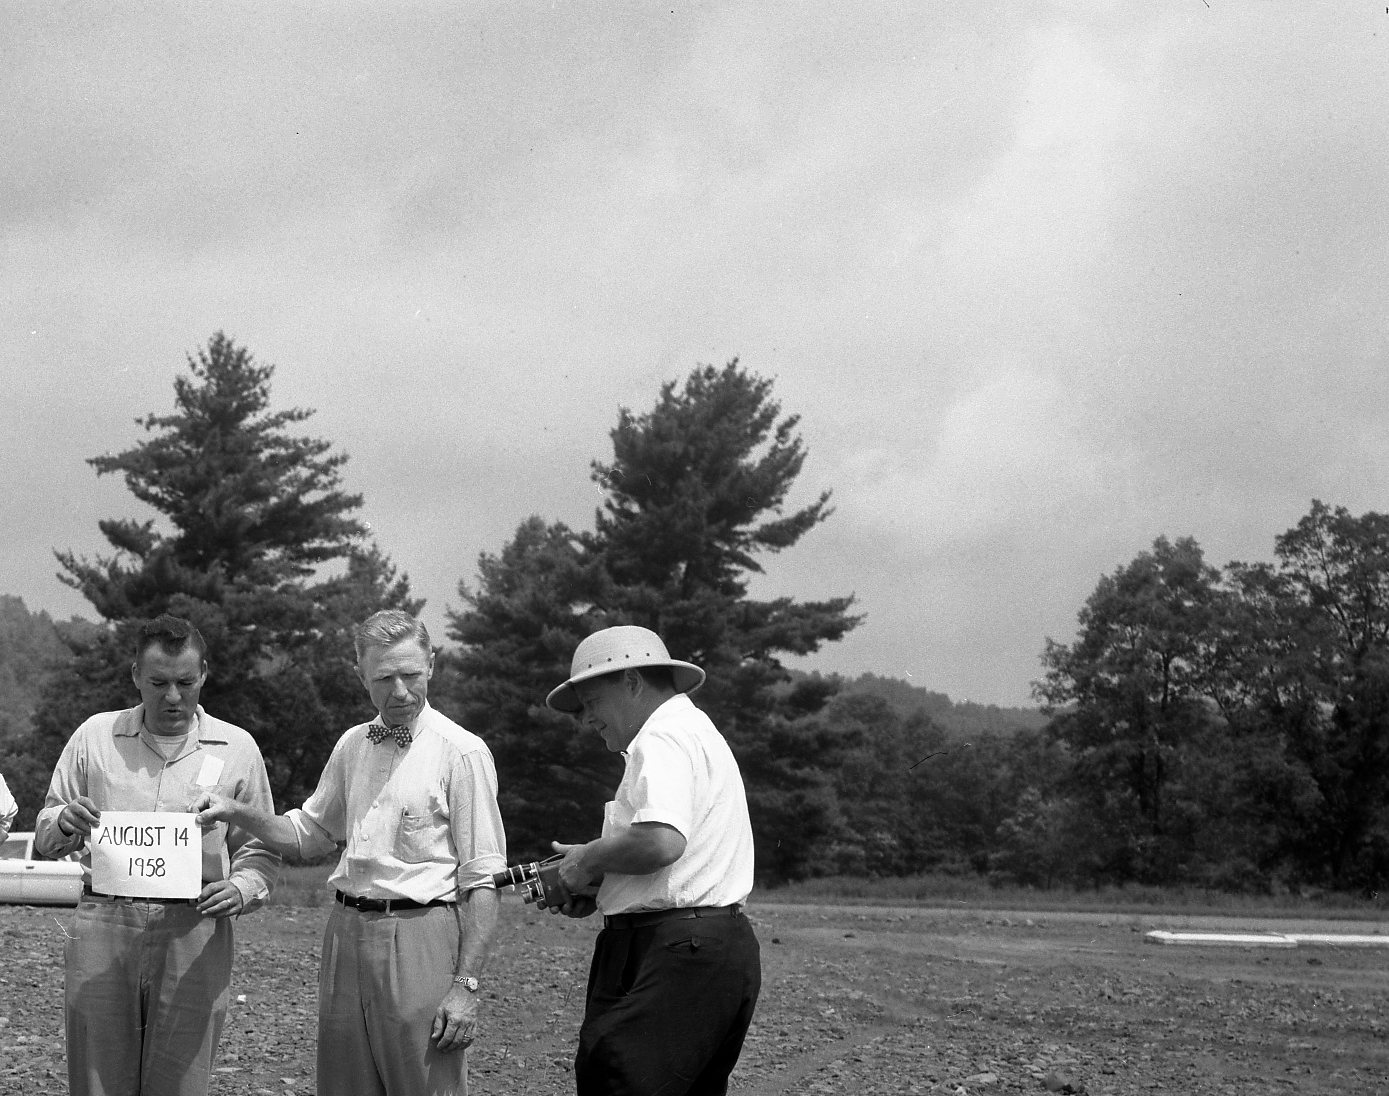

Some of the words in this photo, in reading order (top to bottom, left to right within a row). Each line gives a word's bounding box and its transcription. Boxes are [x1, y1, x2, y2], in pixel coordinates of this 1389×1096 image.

[98, 826, 166, 846] AUGUST
[175, 827, 189, 846] 14
[128, 857, 166, 877] 1958
